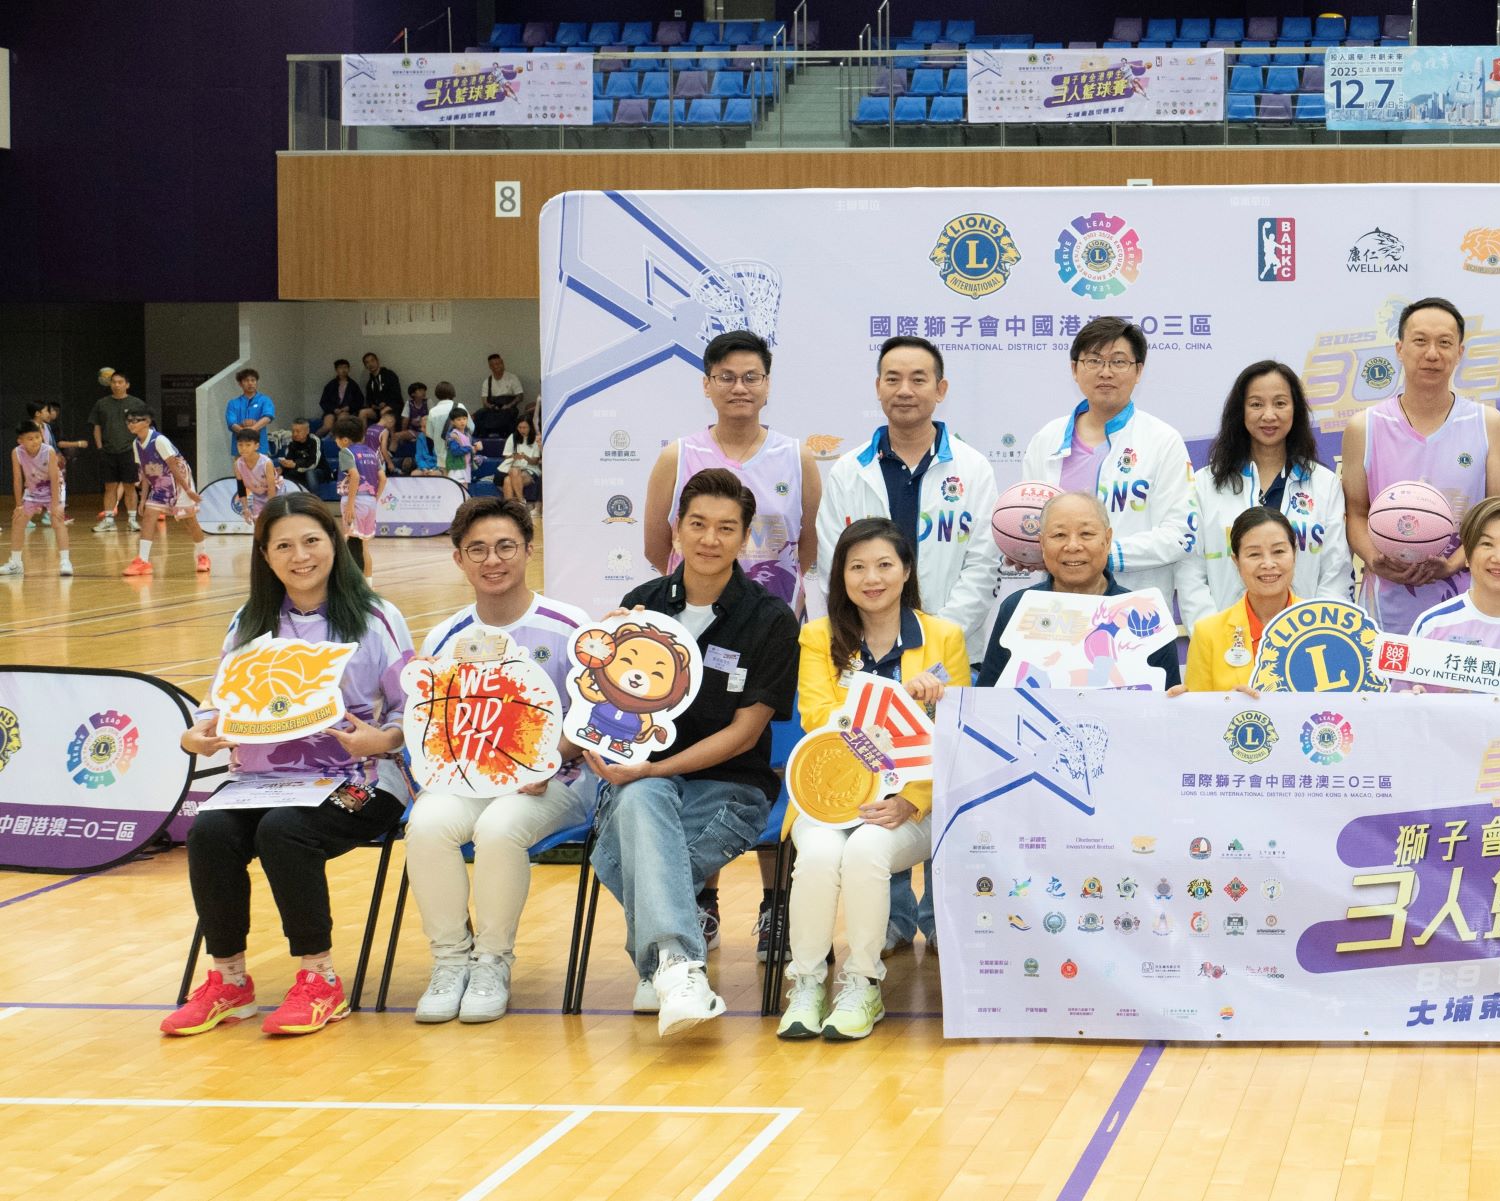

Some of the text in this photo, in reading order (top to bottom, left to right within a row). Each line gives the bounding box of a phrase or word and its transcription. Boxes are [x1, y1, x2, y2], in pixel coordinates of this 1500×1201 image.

[1330, 67, 1358, 77] 2025
[499, 186, 517, 214] 8
[950, 216, 1003, 239] LIONS
[1086, 220, 1112, 229] LEAD
[965, 240, 989, 269] L
[1064, 240, 1073, 273] SERVE
[1280, 220, 1292, 279] BAHKC
[949, 276, 1002, 293] INTERNATIONAL
[937, 342, 1213, 351] NTERNATIONAL DISTRICT 303 CHINA
[1273, 604, 1355, 643] LIONS
[1305, 644, 1349, 692] L
[1409, 666, 1430, 677] JOY
[460, 668, 501, 699] WE
[100, 716, 121, 726] LEAD
[229, 706, 333, 734] LIONS CLUBS BASKETBALL TEAM
[453, 697, 503, 736] DID
[614, 710, 624, 721] 8
[1236, 713, 1269, 725] LIONS
[460, 726, 504, 761] IT!
[1245, 726, 1260, 746] L
